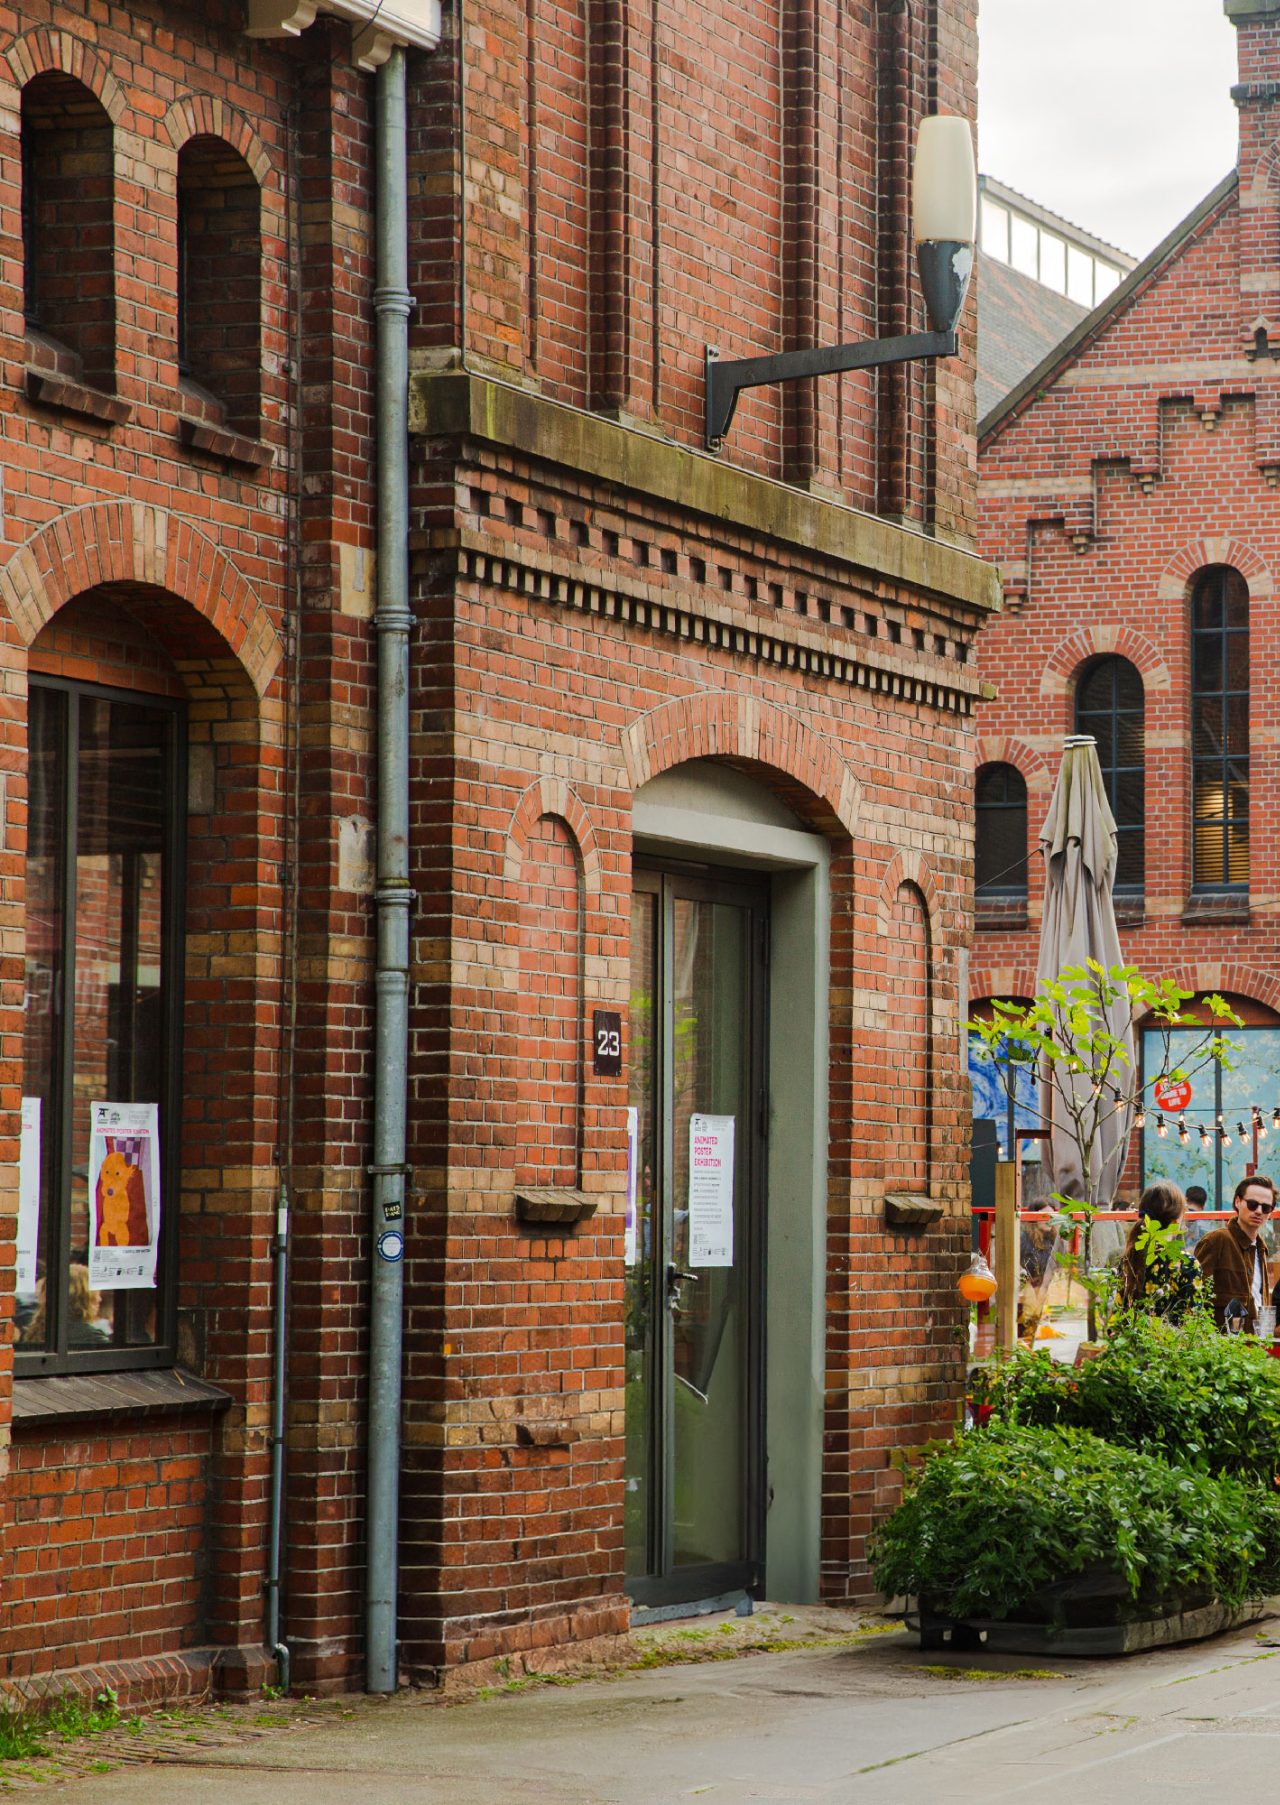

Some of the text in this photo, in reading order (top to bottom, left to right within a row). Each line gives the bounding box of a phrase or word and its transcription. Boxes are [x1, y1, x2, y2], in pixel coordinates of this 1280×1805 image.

[597, 1030, 620, 1056] 23
[694, 1136, 718, 1145] ANIMATED
[694, 1146, 712, 1156] POSTER
[694, 1158, 722, 1167] EXHIBITION
